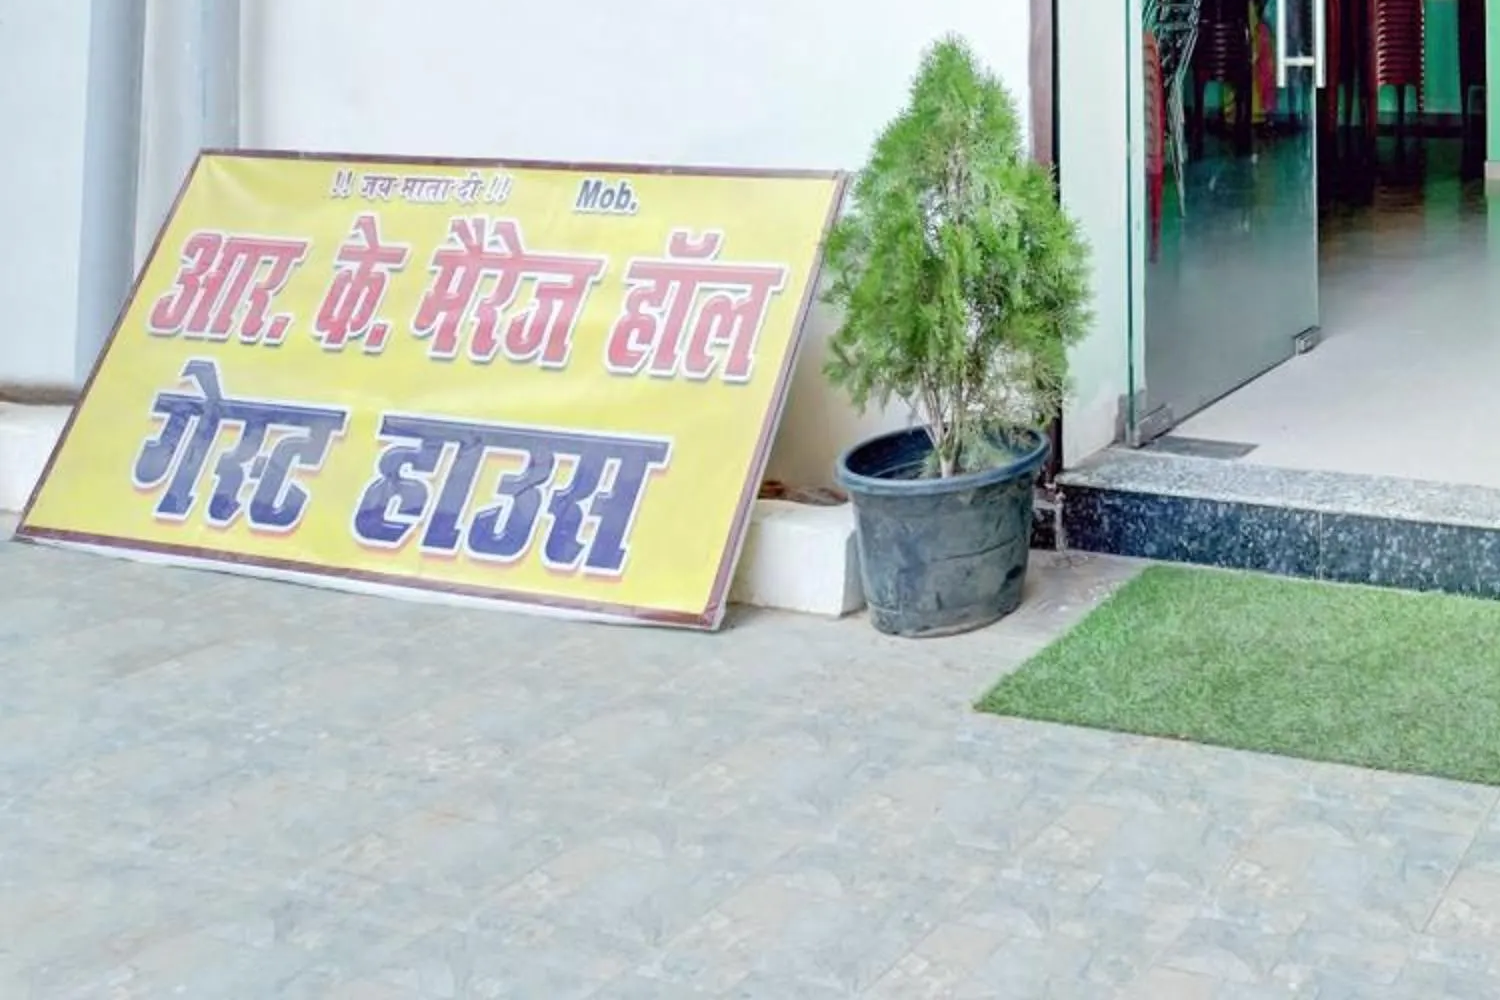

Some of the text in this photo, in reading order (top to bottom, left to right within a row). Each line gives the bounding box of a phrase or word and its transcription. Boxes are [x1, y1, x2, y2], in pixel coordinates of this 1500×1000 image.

[362, 175, 398, 197] जय
[401, 177, 456, 199] माता
[458, 171, 484, 200] दी
[576, 180, 638, 212] Mob.
[151, 214, 786, 381] आर. के. मैरेज हॉल
[133, 357, 672, 573] गेस्ट हाउस
